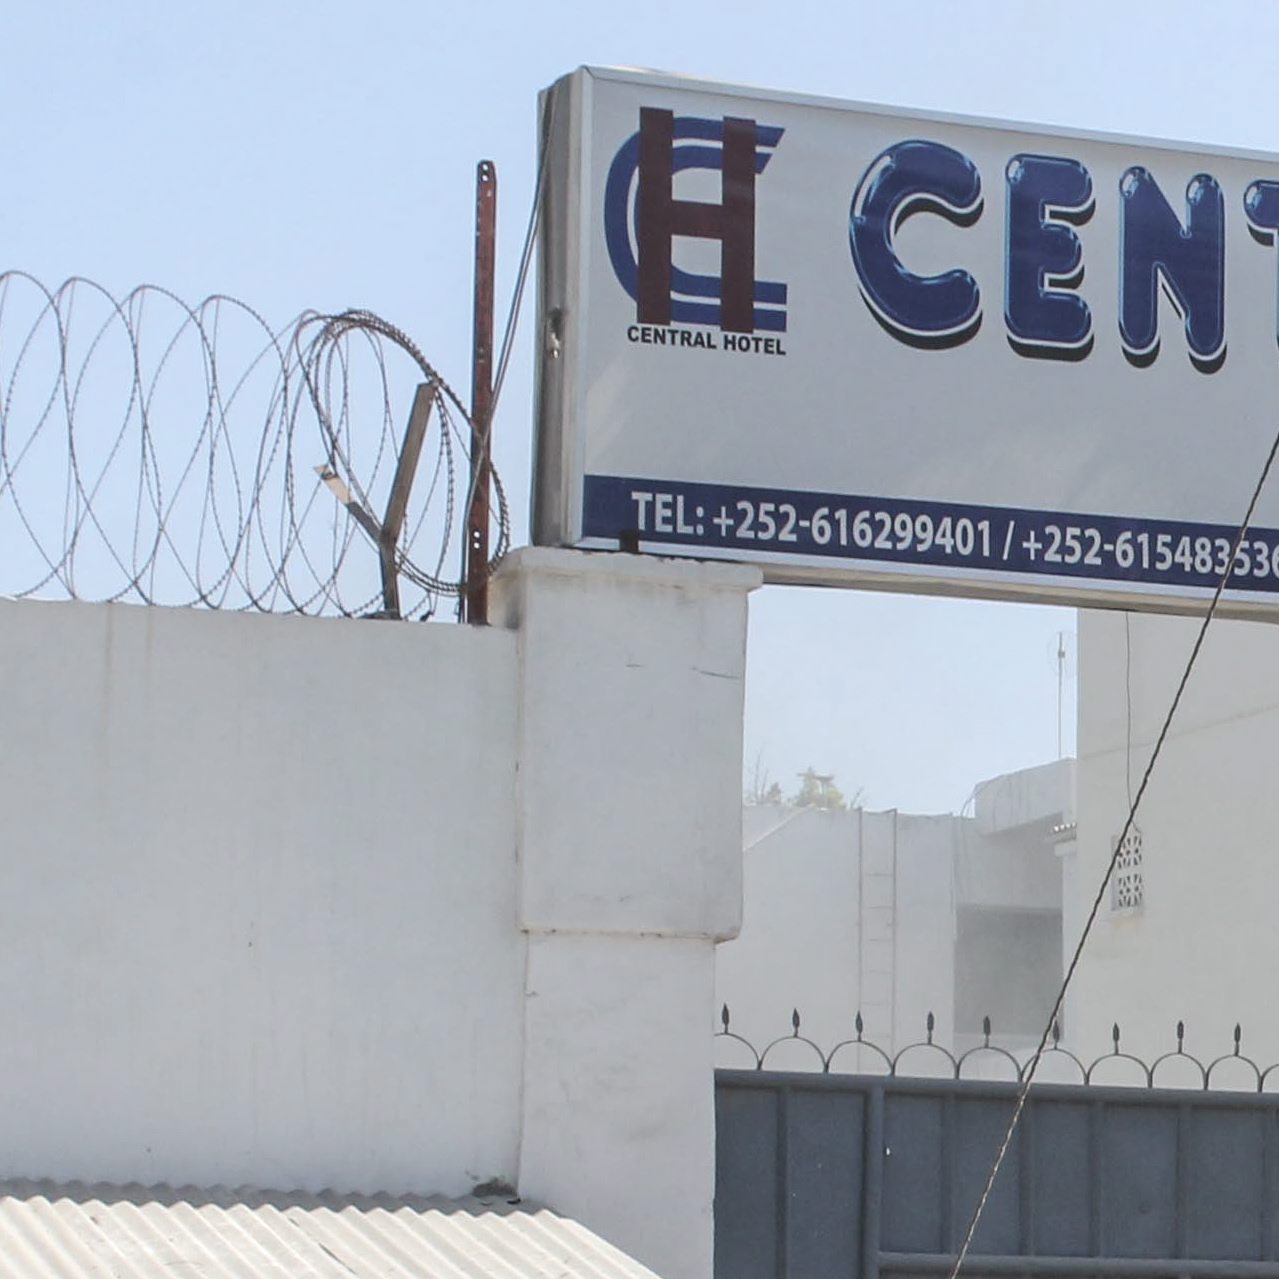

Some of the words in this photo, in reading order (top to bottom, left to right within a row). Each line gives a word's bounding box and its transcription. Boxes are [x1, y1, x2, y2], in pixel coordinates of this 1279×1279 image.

[627, 325, 717, 349] CENTRAL
[723, 333, 787, 356] HOTEL
[631, 490, 705, 536] TEL:
[713, 500, 991, 558] +252-616299401
